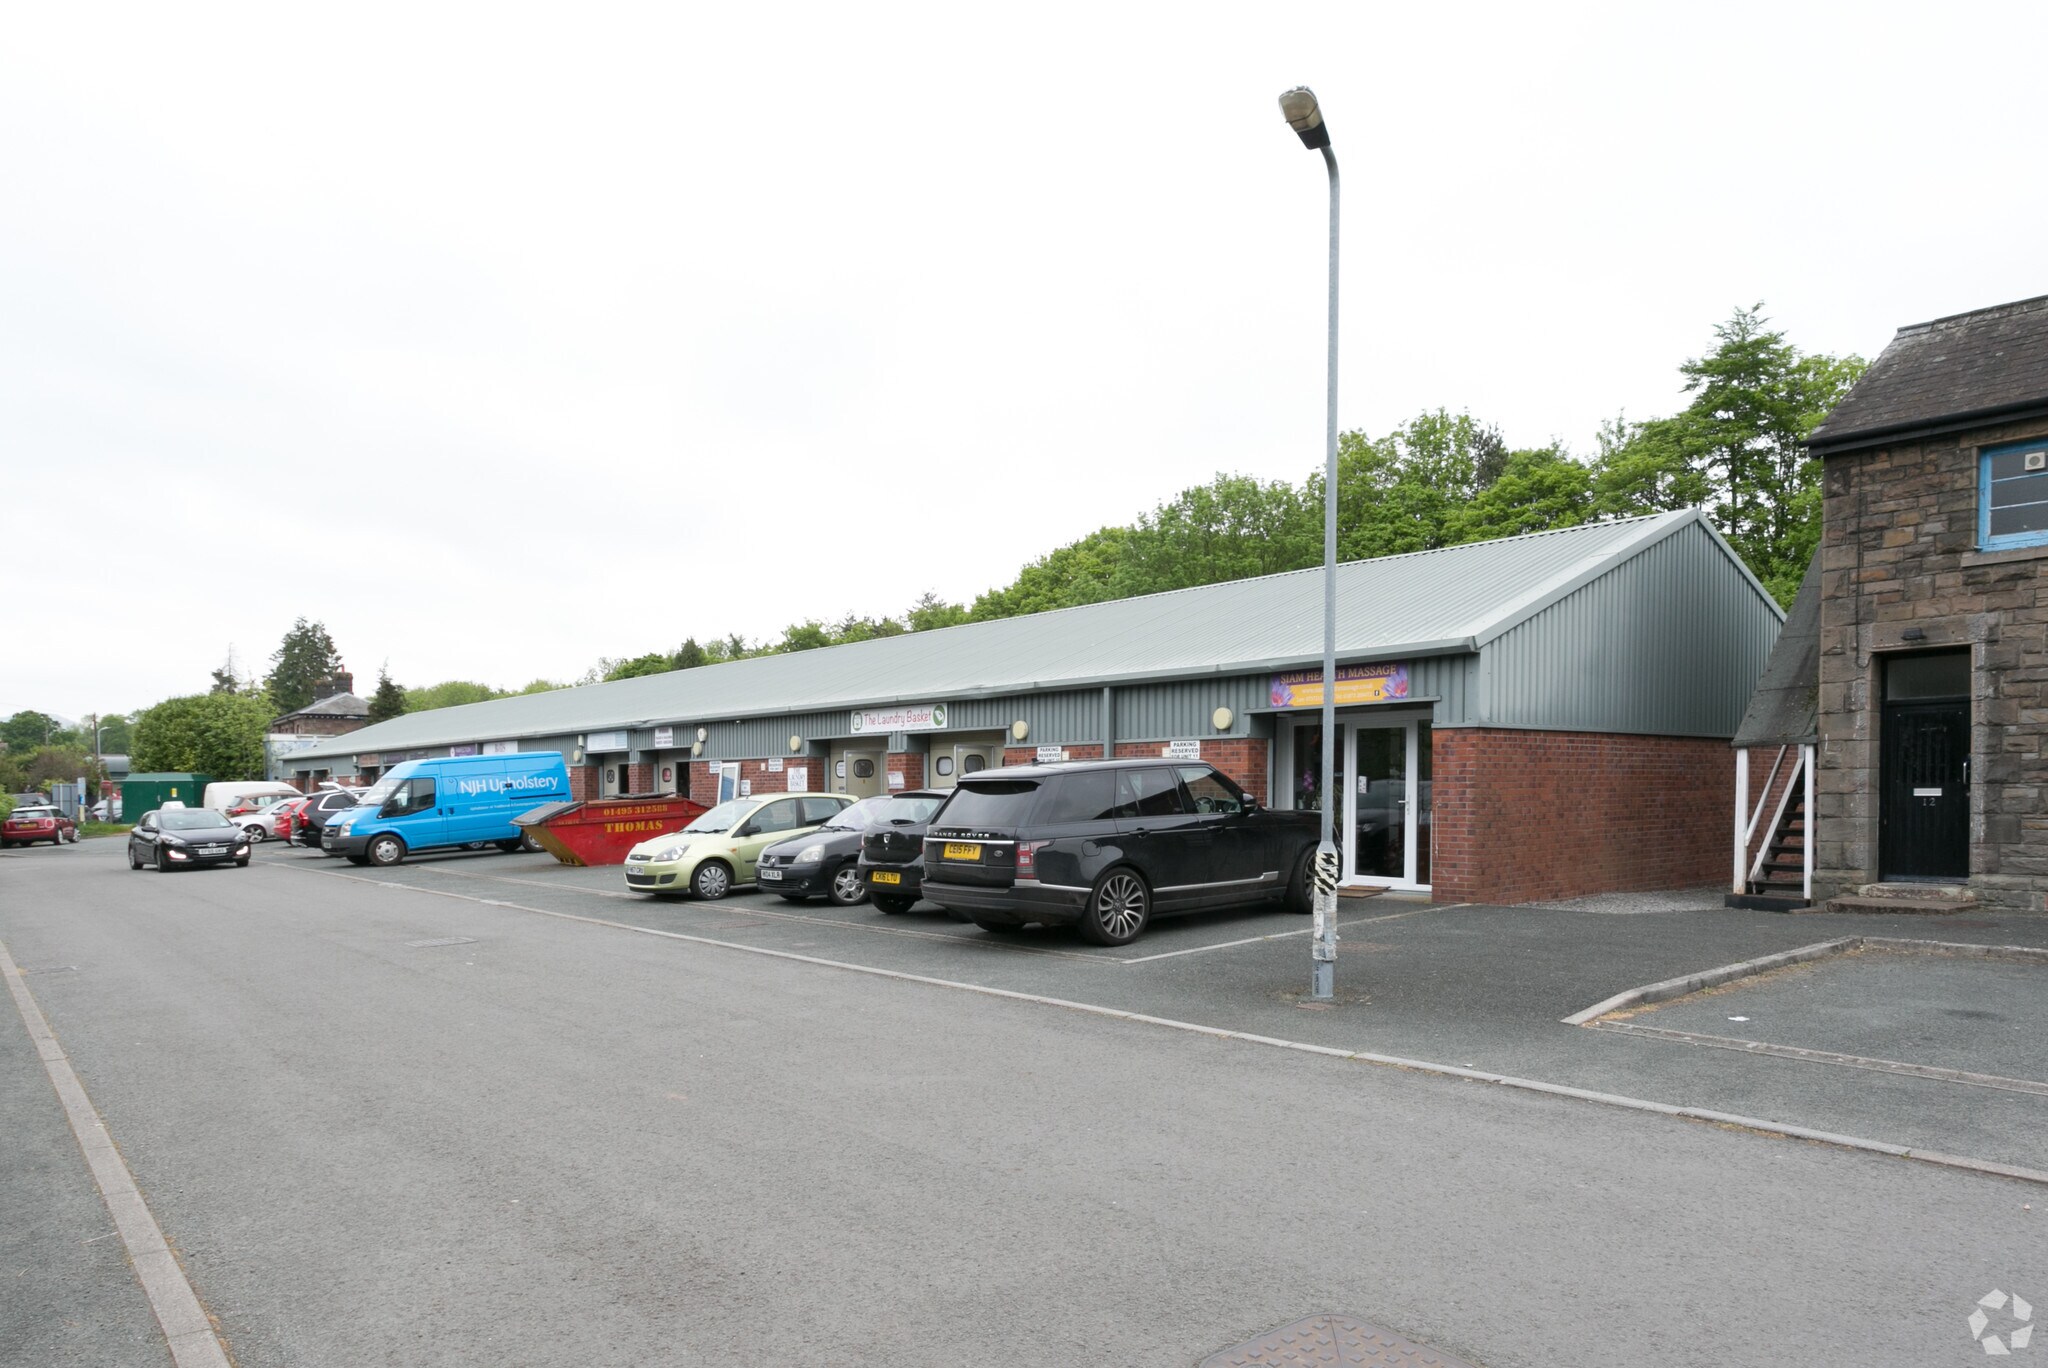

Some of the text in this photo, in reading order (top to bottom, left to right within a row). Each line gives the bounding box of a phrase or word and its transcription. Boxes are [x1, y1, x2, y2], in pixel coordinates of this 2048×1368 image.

[1280, 664, 1397, 684] SIAM HEAH MASSAGE
[864, 713, 876, 725] The
[878, 711, 905, 727] Laundry
[906, 708, 931, 723] Basket
[460, 775, 558, 797] NJH Upholstery
[603, 806, 633, 816] 01495
[605, 819, 663, 833] THOMAS
